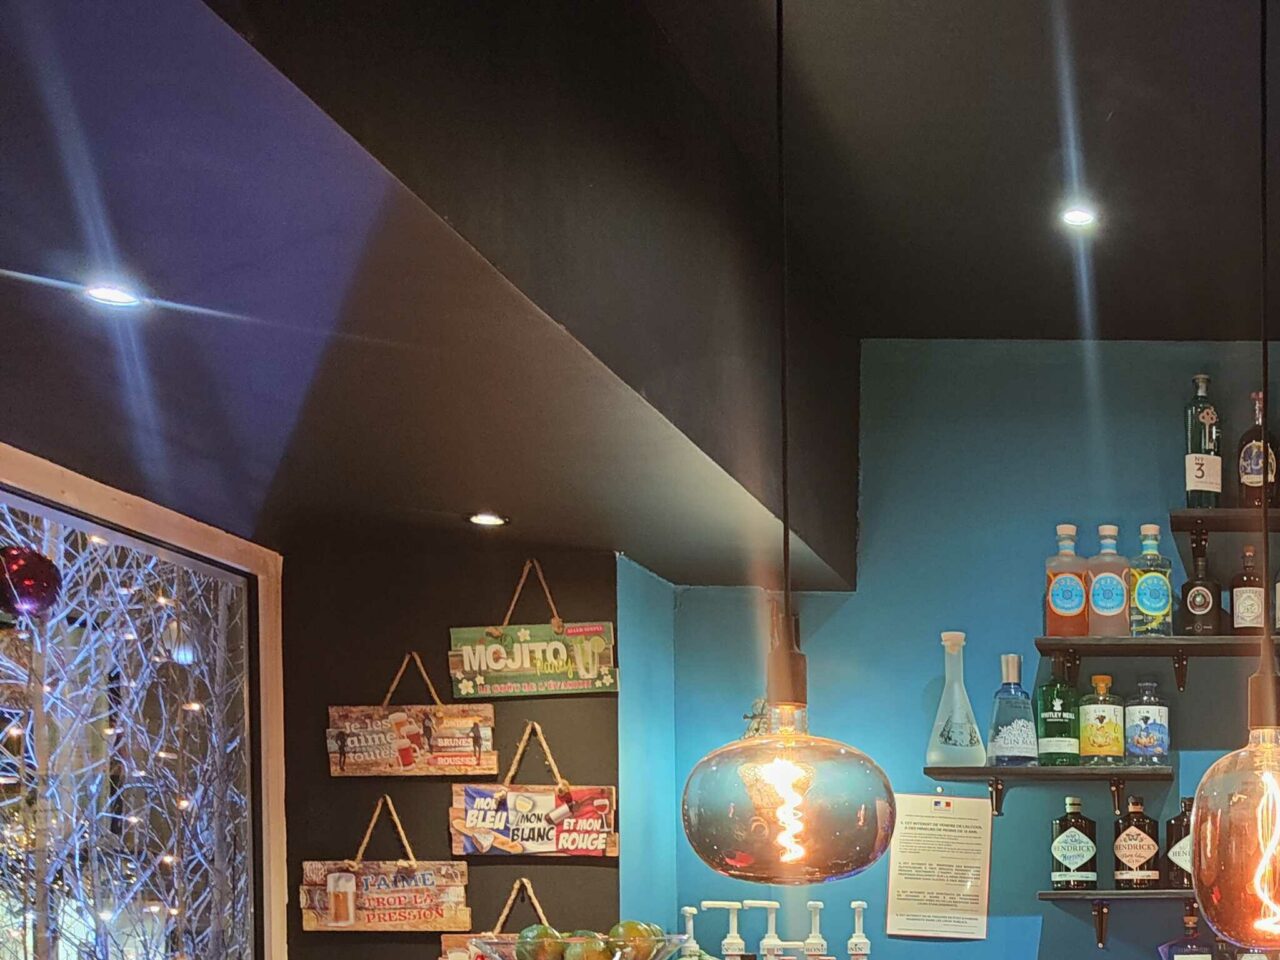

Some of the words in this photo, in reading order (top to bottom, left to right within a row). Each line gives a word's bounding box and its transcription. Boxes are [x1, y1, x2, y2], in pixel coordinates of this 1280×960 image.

[1194, 462, 1205, 479] 3
[462, 641, 568, 672] MOJITO
[345, 721, 361, 733] Je
[365, 718, 391, 731] les
[347, 731, 397, 748] aime
[438, 737, 474, 747] BRUNES
[349, 749, 398, 763] toutes
[474, 797, 497, 810] MON
[466, 810, 507, 830] BLEU
[520, 812, 544, 824] MON
[562, 818, 576, 830] ET
[576, 818, 602, 831] MON
[510, 825, 556, 843] BLANC
[558, 832, 608, 850] ROUGE
[362, 872, 435, 892] J'AIME
[364, 894, 408, 908] TROP
[413, 892, 435, 905] LA
[365, 908, 445, 924] PRESSION
